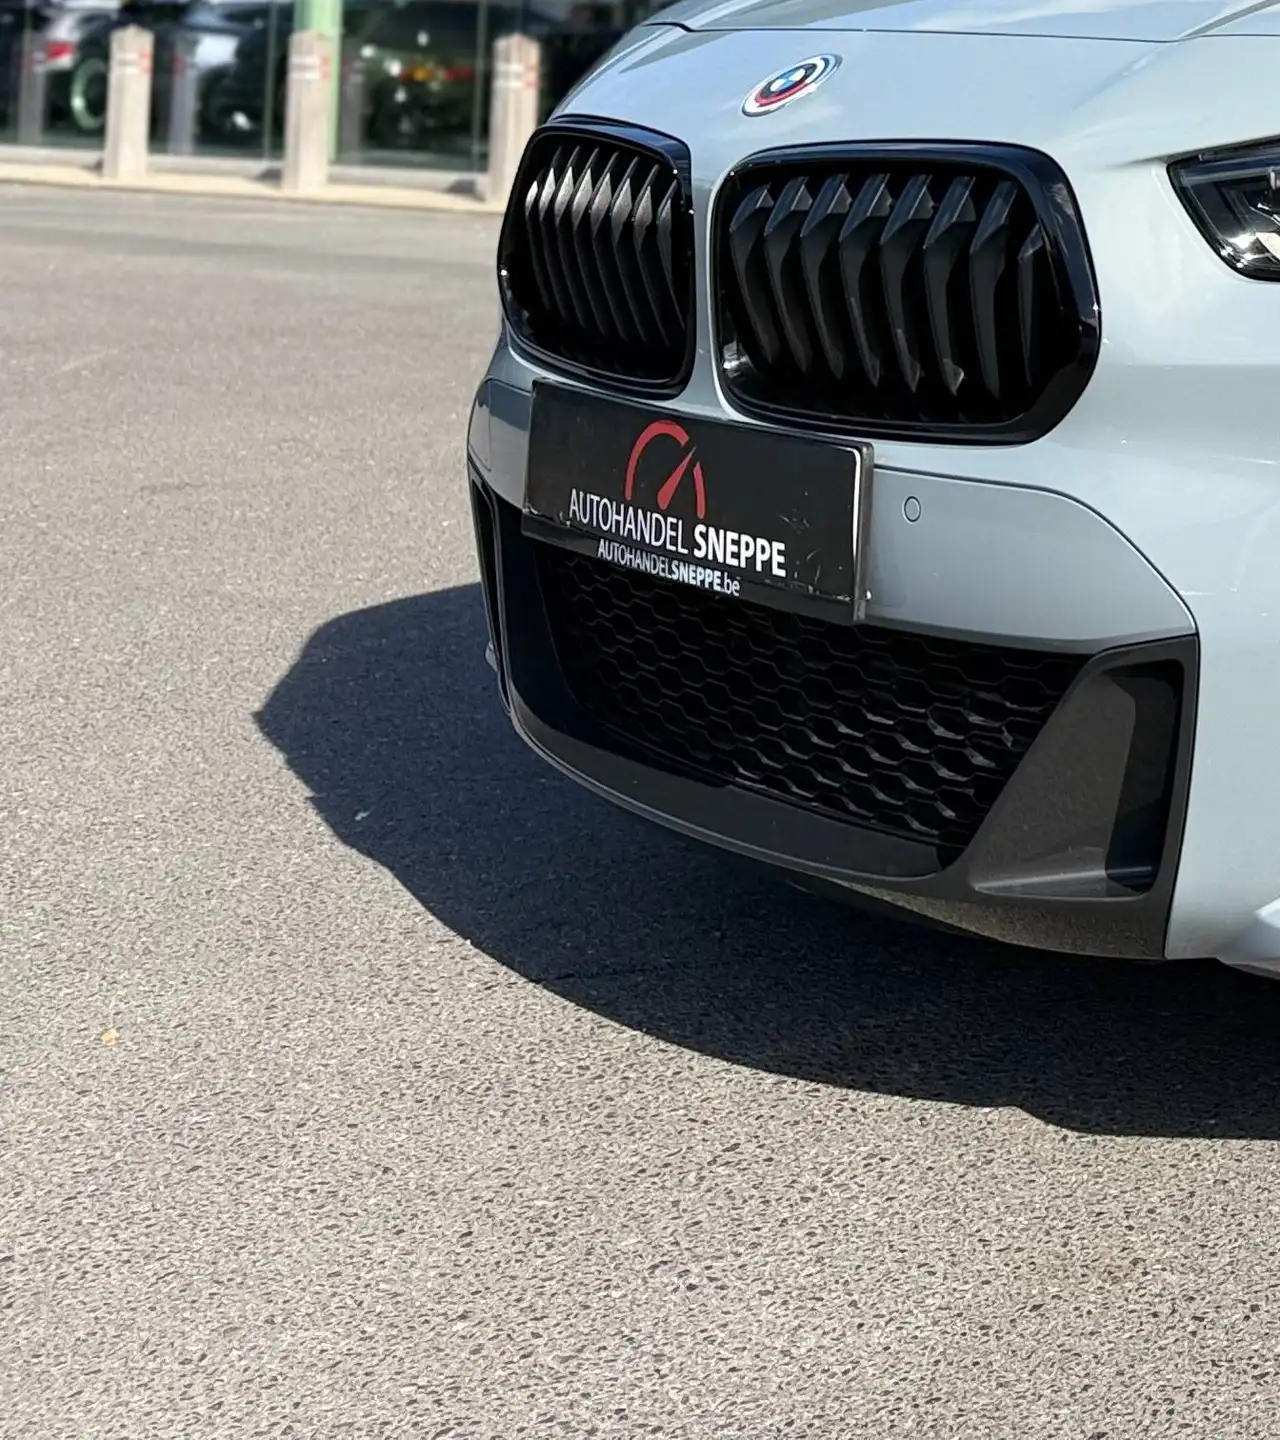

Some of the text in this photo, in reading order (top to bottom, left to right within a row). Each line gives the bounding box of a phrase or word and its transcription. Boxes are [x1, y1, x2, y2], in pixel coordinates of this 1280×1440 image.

[568, 488, 787, 577] AUTOHANDEL SNEPPE
[597, 538, 741, 597] AUTOHANDELSNEPPE.be
